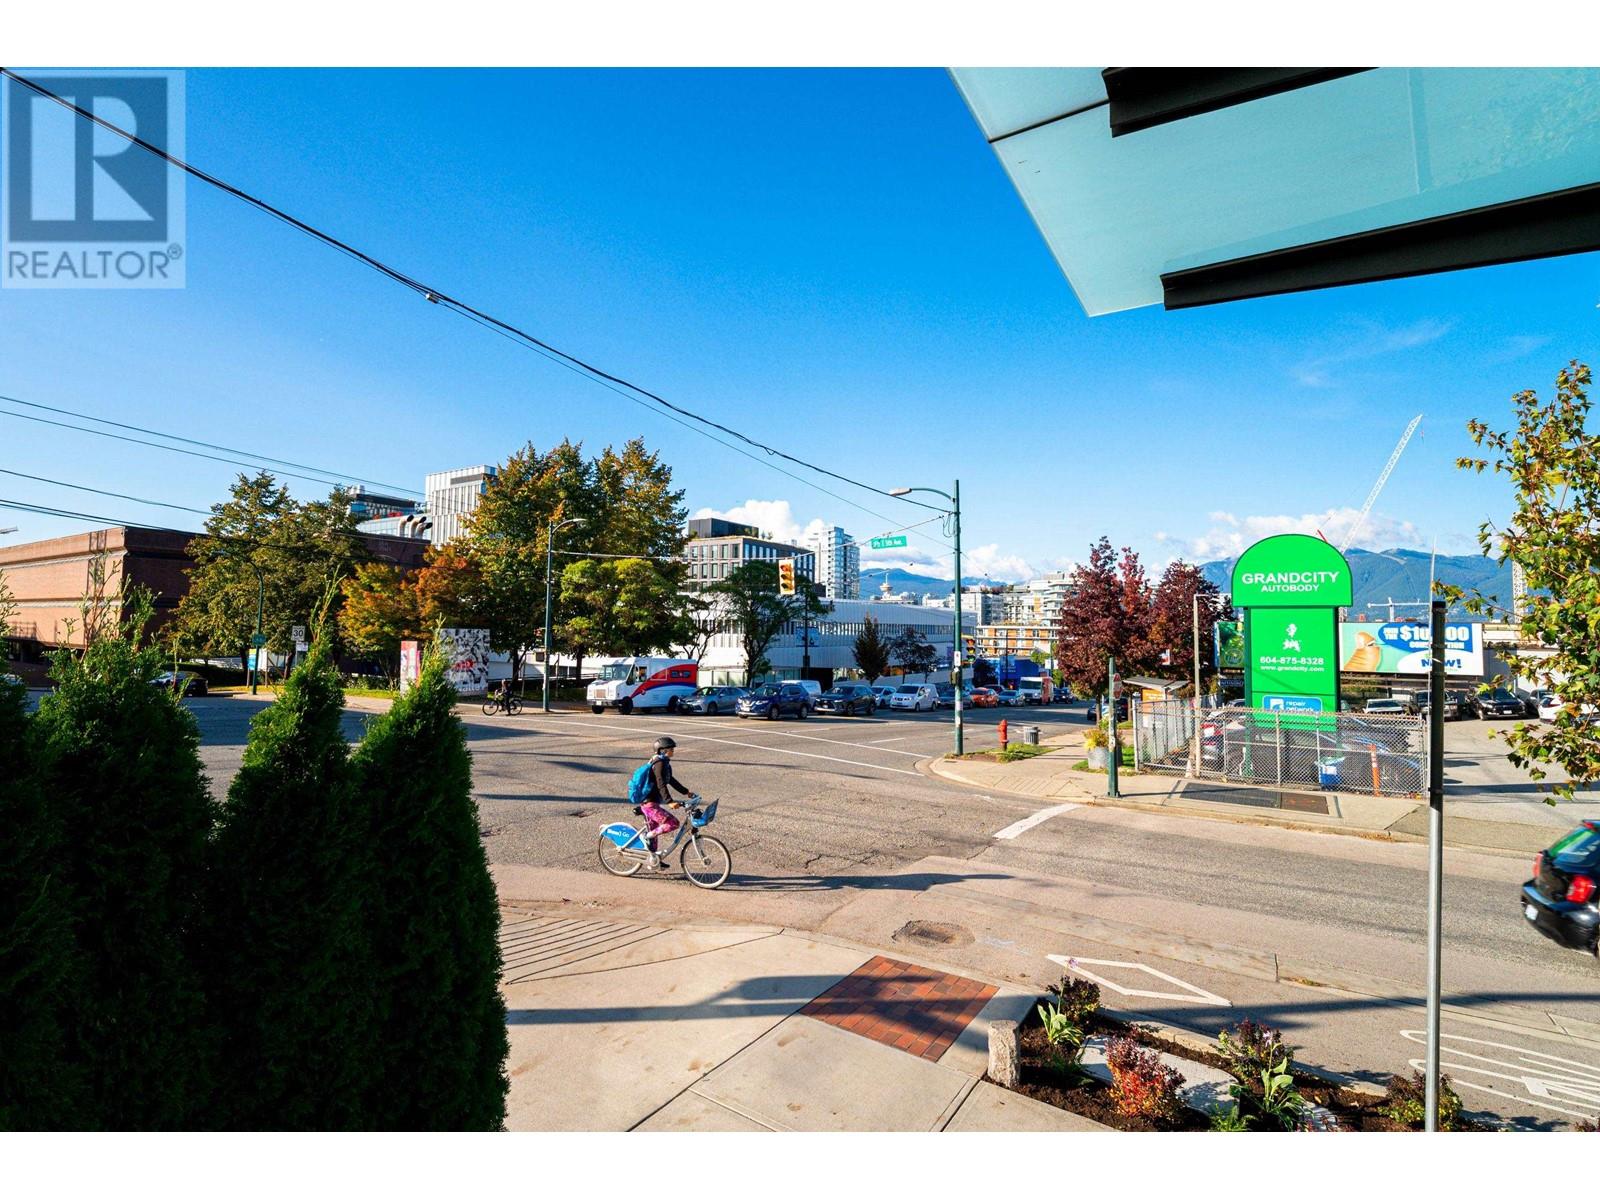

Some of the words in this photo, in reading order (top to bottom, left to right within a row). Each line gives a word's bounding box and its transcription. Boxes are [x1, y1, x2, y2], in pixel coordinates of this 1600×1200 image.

[1241, 571, 1340, 585] GRANDCITY
[1261, 584, 1320, 592] AUTOBODY
[293, 629, 304, 637] 30
[1260, 656, 1324, 665] 604-875-8328
